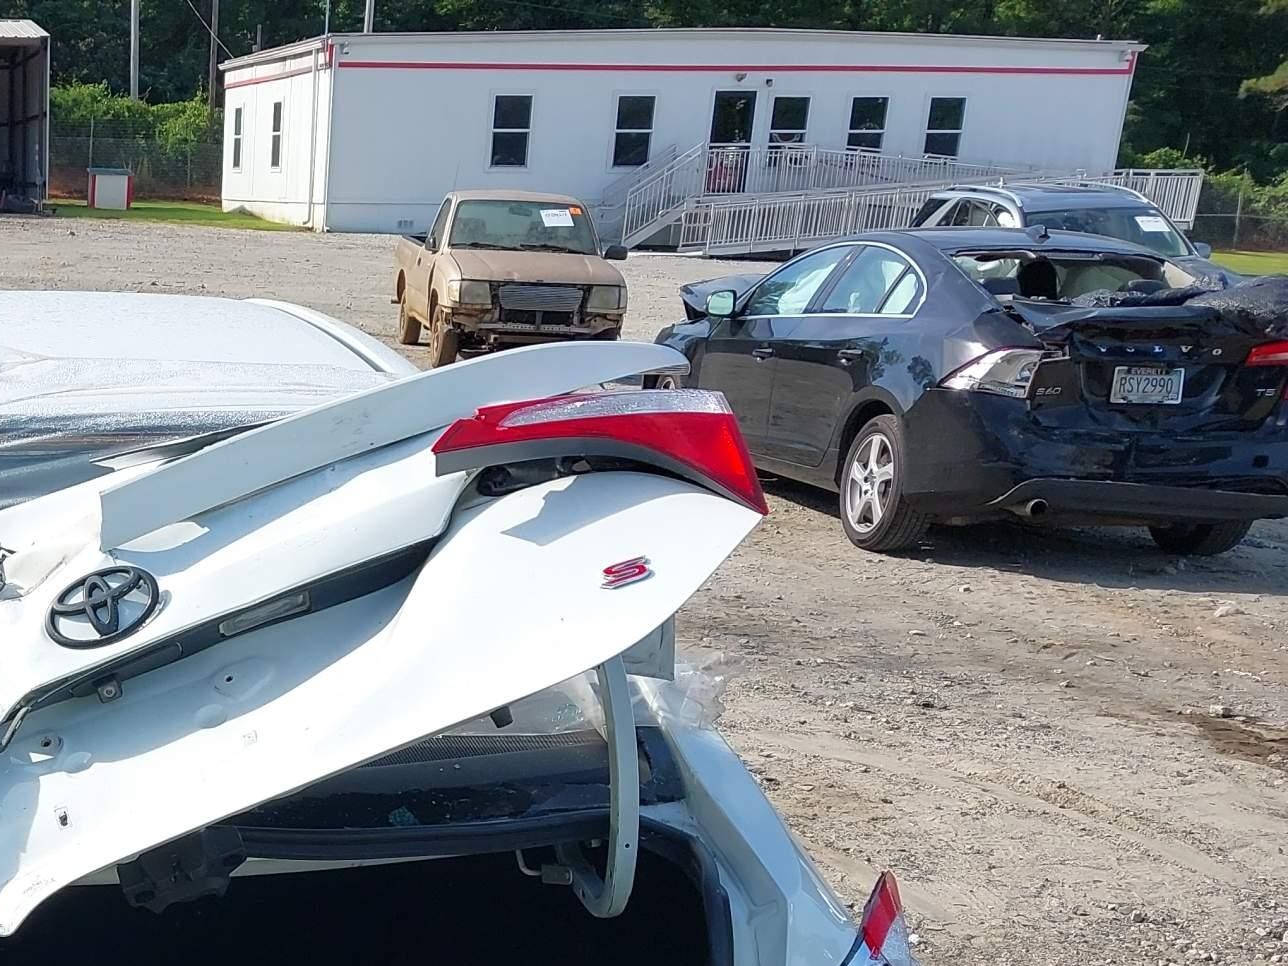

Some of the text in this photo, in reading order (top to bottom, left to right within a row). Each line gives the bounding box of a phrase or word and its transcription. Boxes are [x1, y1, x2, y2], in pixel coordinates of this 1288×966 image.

[1097, 345, 1223, 356] VOLVO
[1118, 376, 1174, 394] RSY2990
[1035, 386, 1062, 396] S60
[1256, 388, 1277, 397] T5
[600, 555, 650, 589] S
